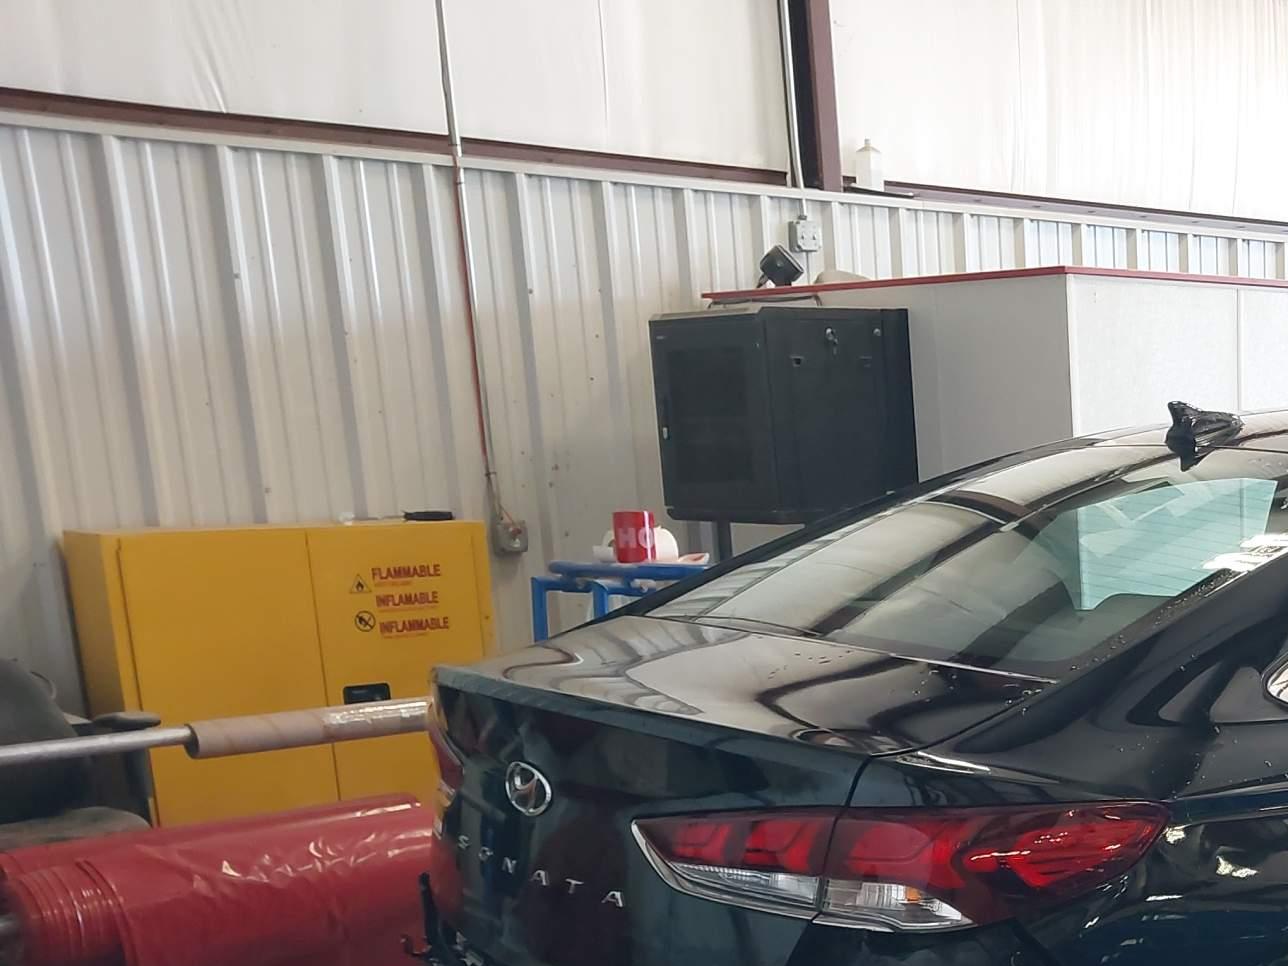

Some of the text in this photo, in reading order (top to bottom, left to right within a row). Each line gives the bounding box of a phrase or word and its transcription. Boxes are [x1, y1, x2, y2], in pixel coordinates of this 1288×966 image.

[371, 564, 442, 580] FLAMMABLE
[376, 591, 439, 607] INFLAMABLE
[379, 617, 450, 634] INFLAMMABLE
[457, 834, 625, 908] SONATA
